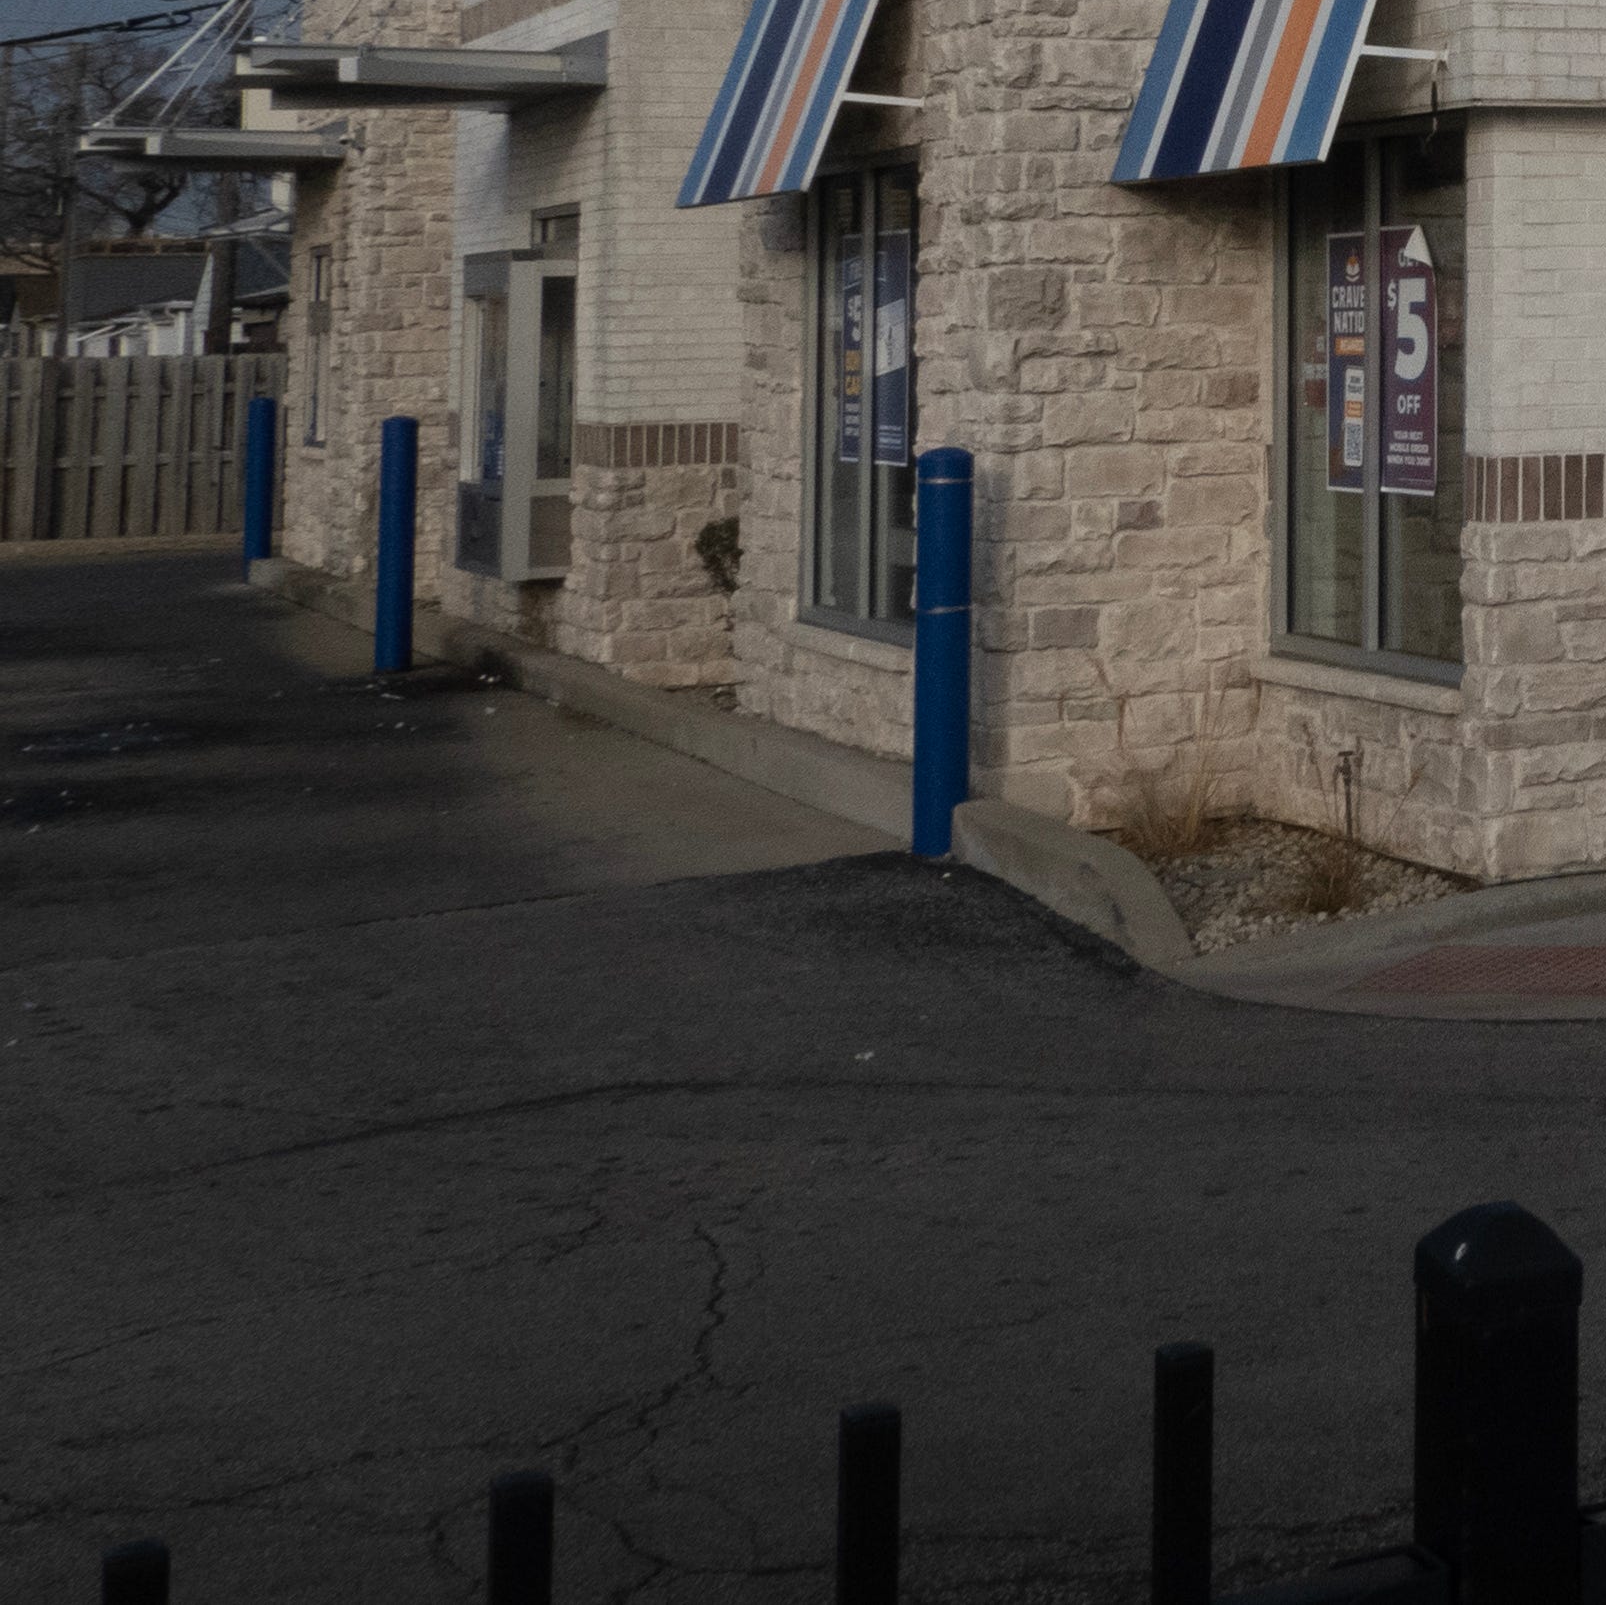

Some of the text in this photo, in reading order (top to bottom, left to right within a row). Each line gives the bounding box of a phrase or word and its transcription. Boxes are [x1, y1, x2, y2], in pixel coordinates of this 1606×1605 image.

[1331, 284, 1366, 309] CRAVE
[1333, 310, 1366, 334] NATIO
[1386, 277, 1429, 381] $5
[1396, 393, 1422, 414] OFF
